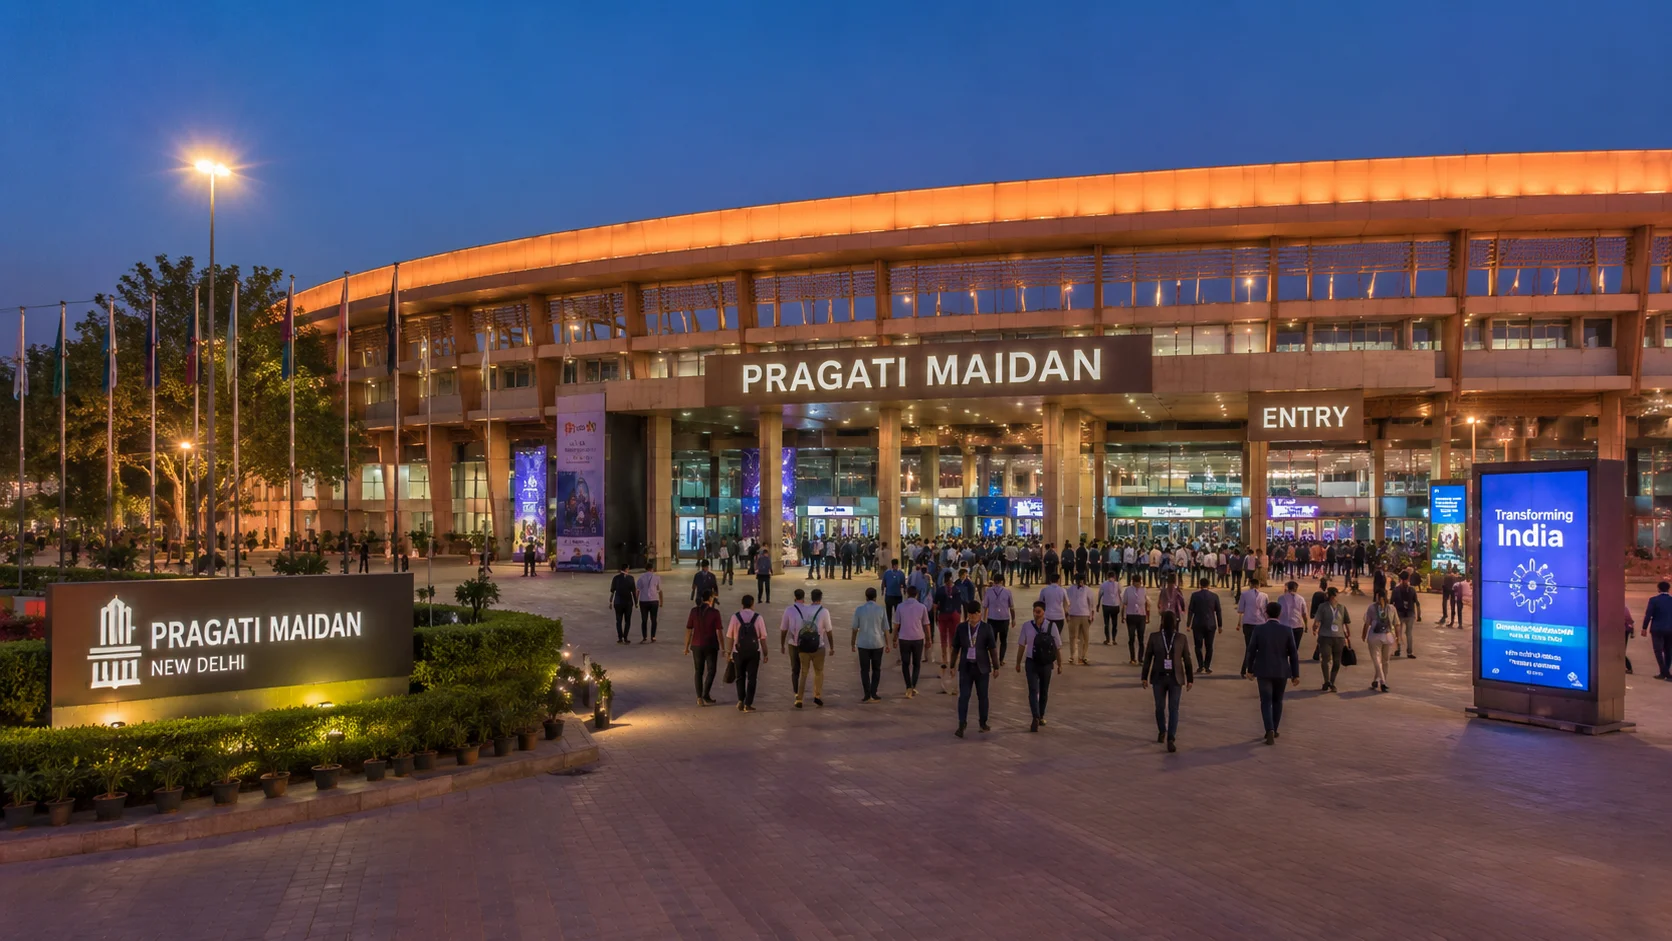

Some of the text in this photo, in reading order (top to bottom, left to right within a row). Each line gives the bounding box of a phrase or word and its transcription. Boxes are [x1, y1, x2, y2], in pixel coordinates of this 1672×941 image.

[741, 348, 1102, 394] PRAGATI MAIDAN
[1262, 406, 1350, 429] ENTRY
[1495, 509, 1574, 523] Transforming
[1498, 523, 1564, 548] India
[151, 611, 362, 650] PRAGATI MAIDAN
[151, 654, 245, 677] NEW DELHI
